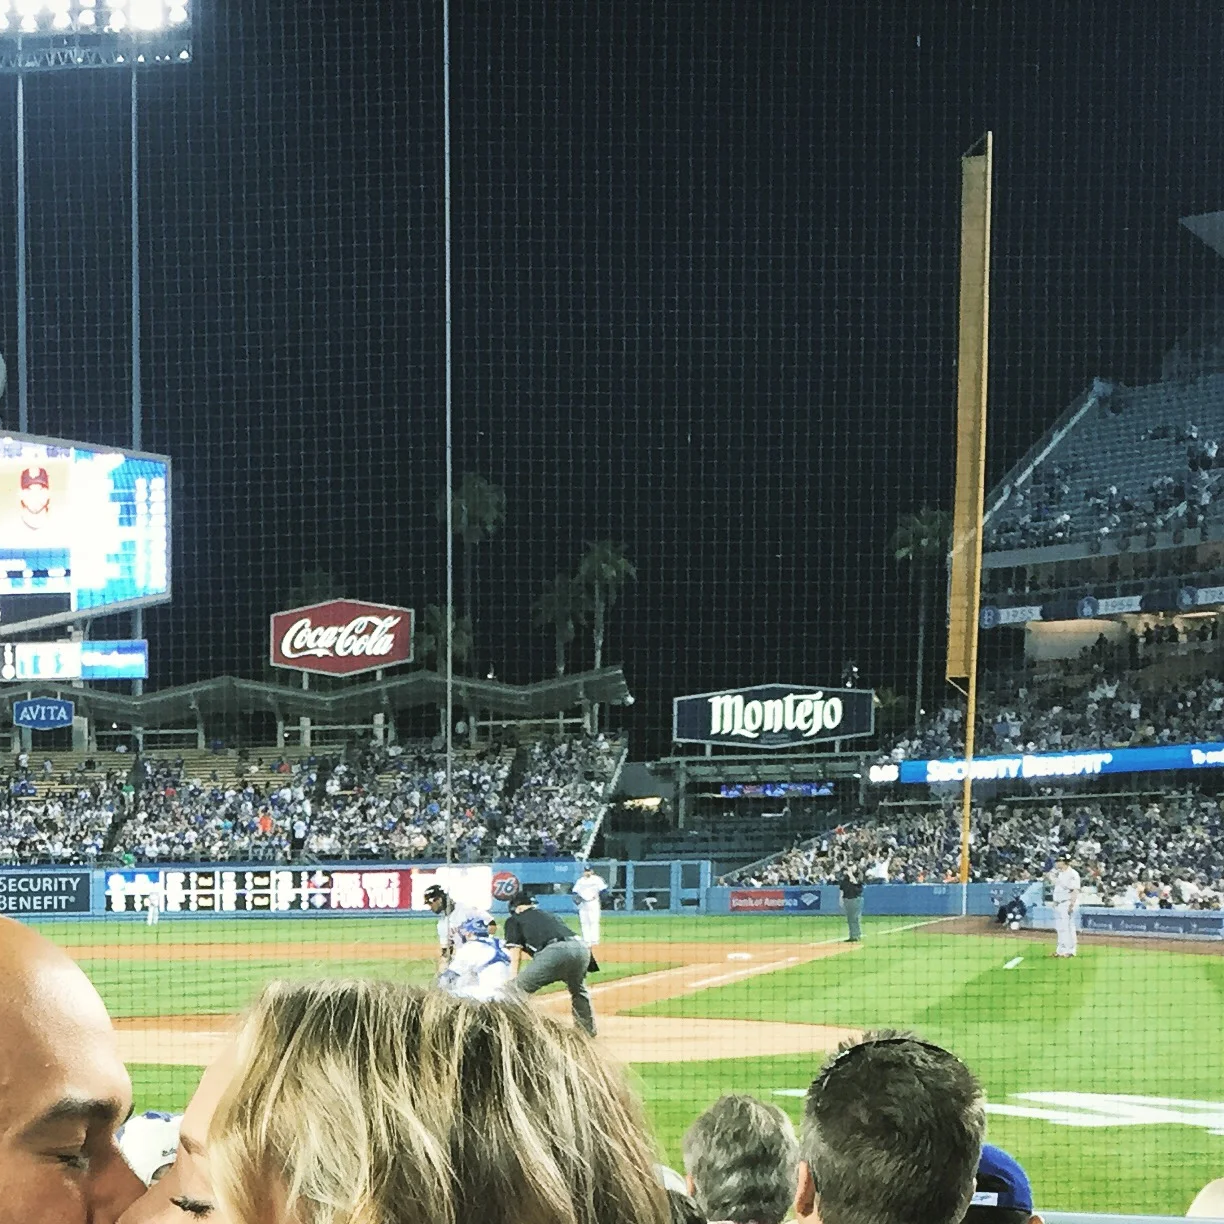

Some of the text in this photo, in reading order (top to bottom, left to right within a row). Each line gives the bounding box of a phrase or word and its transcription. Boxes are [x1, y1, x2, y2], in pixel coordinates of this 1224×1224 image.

[281, 616, 401, 658] Coca-Cola
[19, 705, 68, 720] AVITA
[708, 691, 843, 738] Montejo
[494, 877, 517, 895] 76
